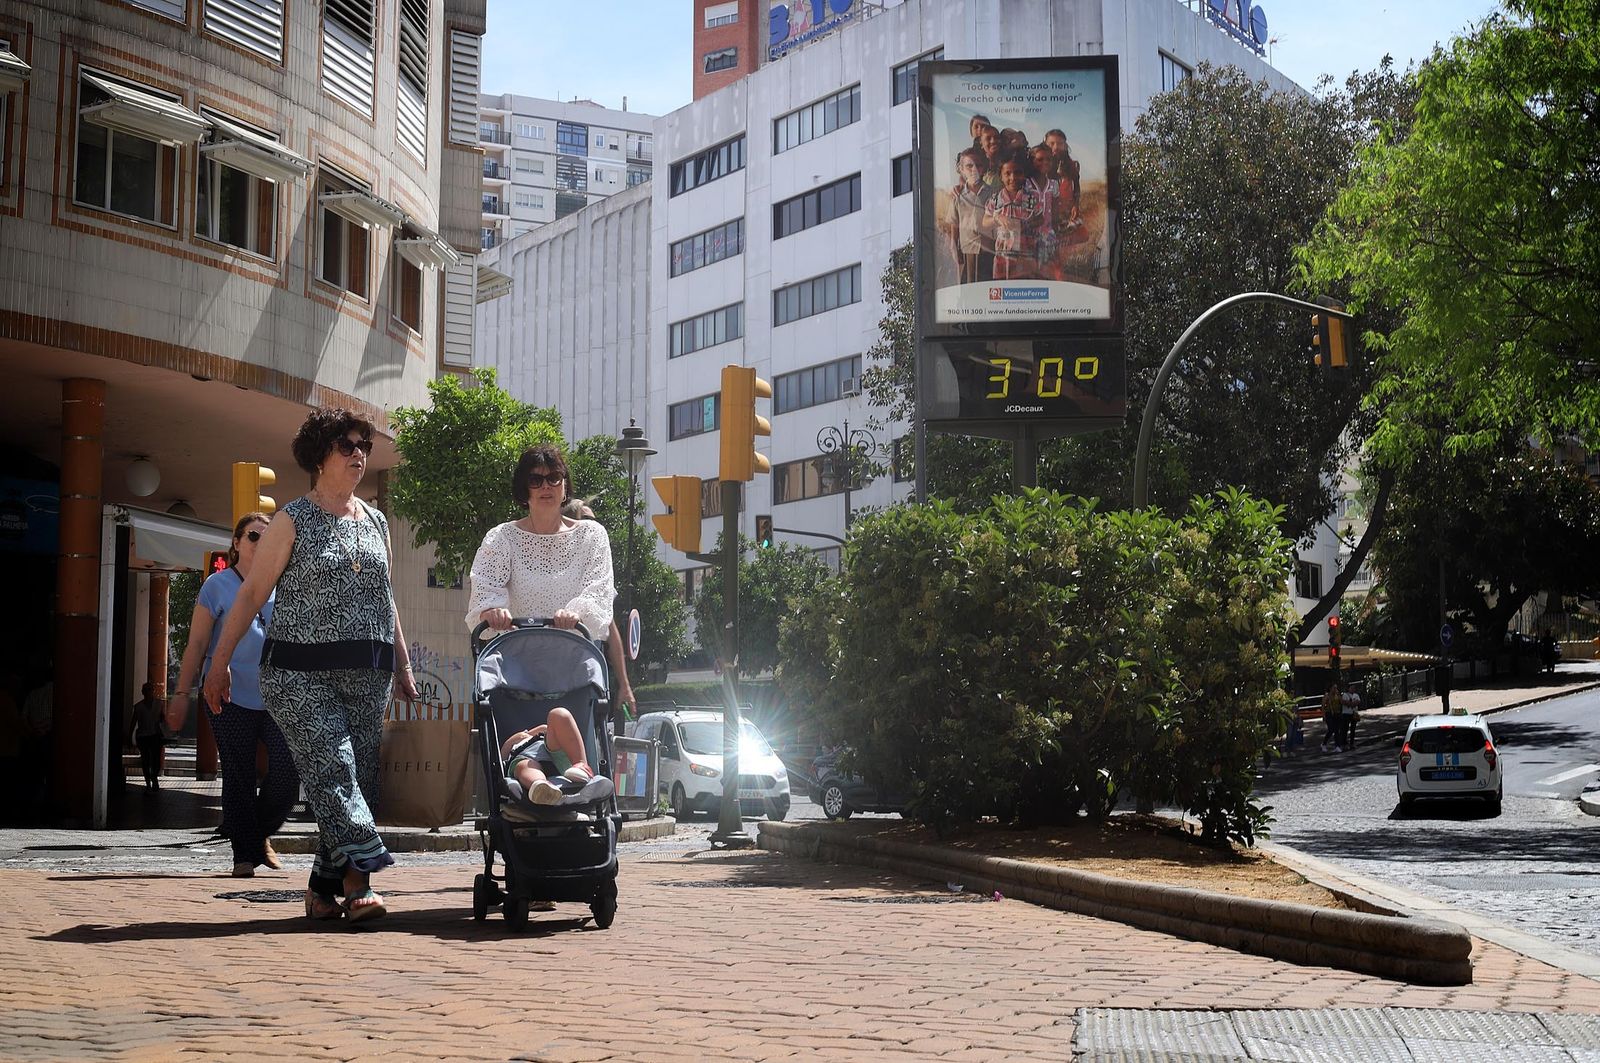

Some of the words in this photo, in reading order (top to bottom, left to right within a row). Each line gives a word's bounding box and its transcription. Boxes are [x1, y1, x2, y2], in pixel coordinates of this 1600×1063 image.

[1009, 82, 1049, 90] humano
[1051, 81, 1075, 90] tiene
[954, 95, 994, 103] derecho
[1026, 94, 1047, 102] vida
[987, 307, 1092, 315] www.fundacionvicenteferrer.org
[1004, 404, 1044, 413] JCDecaux
[383, 761, 445, 773] TEFIEL
